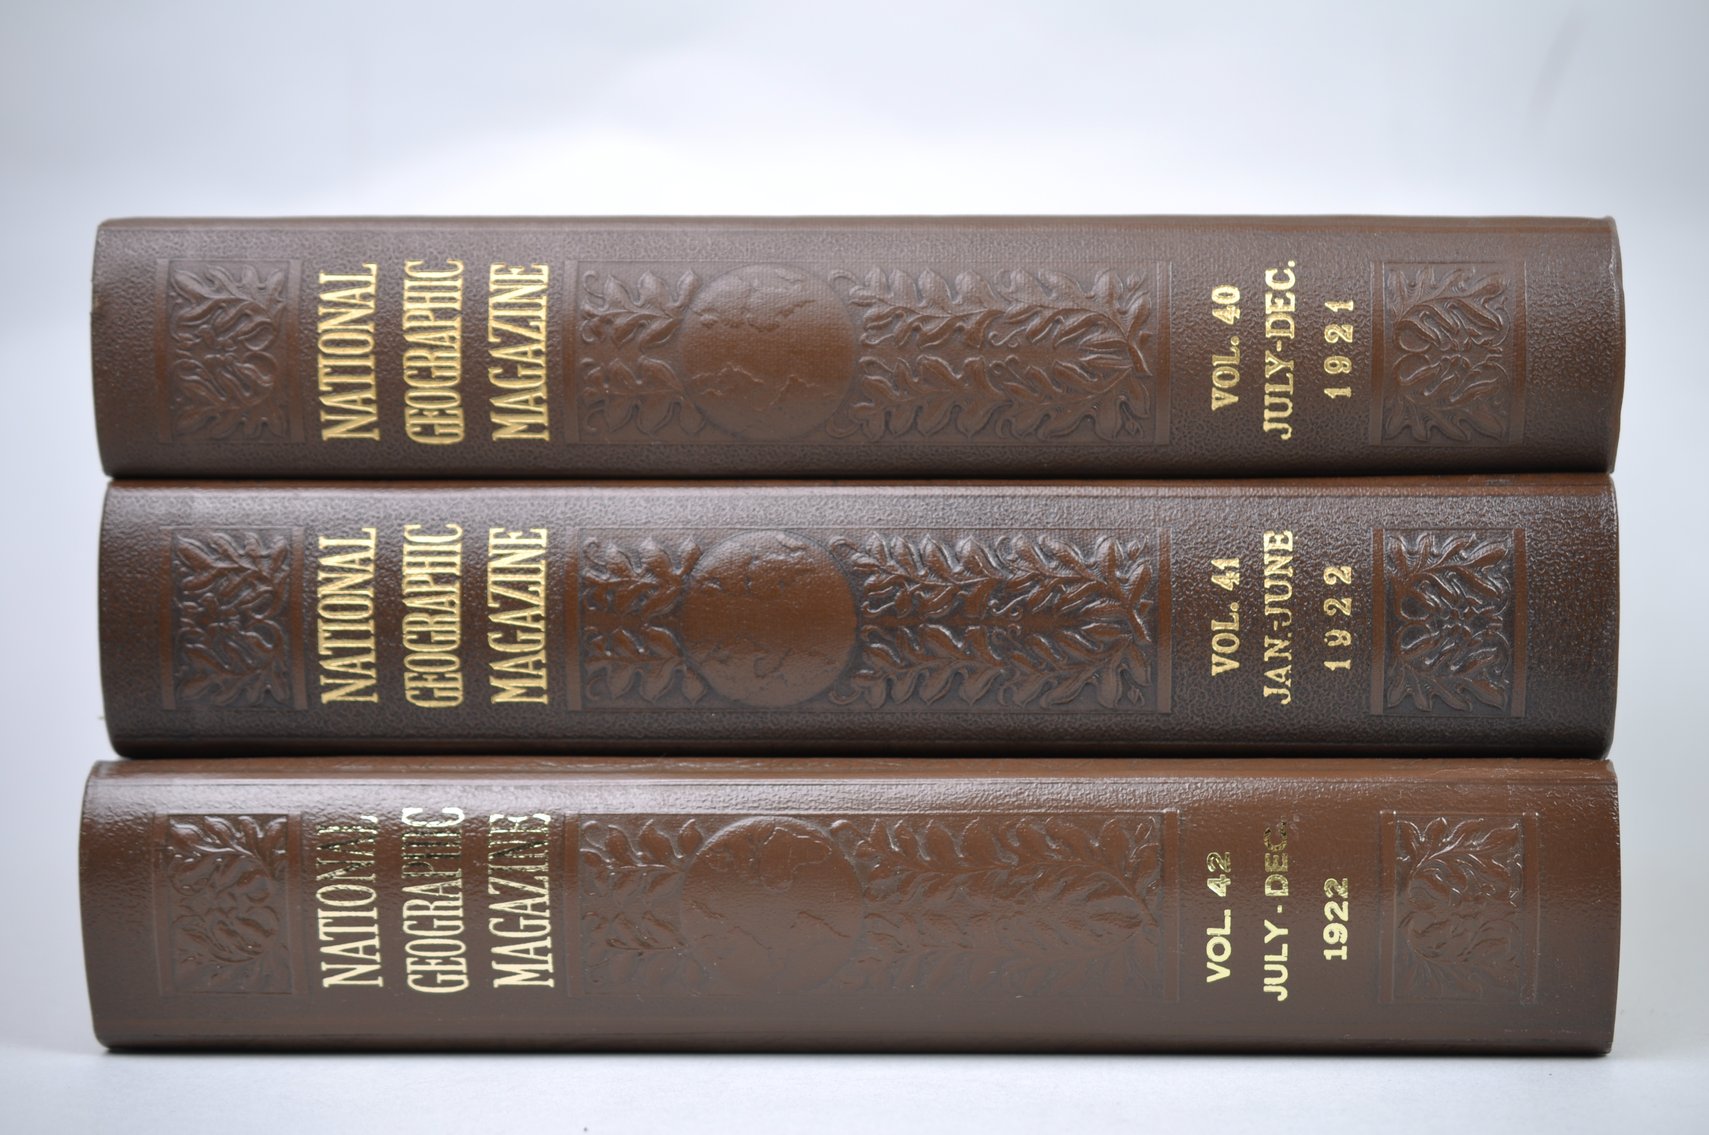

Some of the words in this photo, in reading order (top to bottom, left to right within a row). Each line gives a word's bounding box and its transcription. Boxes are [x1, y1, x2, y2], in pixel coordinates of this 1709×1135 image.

[318, 263, 381, 441] NATIONAL
[402, 260, 465, 445] GEOGRAPHIC
[488, 263, 550, 441] MAGAZINE
[1211, 285, 1240, 325] 40
[1211, 335, 1240, 411] VOL.
[1263, 260, 1296, 440] JULY-DEC.
[1323, 299, 1354, 399] 1921
[317, 527, 378, 704] NATIONAL
[402, 523, 464, 708] GEOGRAPHIC
[487, 527, 549, 705] MAGAZINE
[1211, 557, 1240, 591] 41
[1211, 602, 1240, 677] VOL.
[1323, 565, 1352, 671] 1922
[316, 815, 384, 988] NATIONAL
[401, 807, 470, 994] GEOGRAPHIC
[488, 813, 555, 988] MAGAZINE
[1206, 852, 1232, 897] 42
[1206, 909, 1232, 983] VOL.
[1323, 877, 1349, 961] 1922
